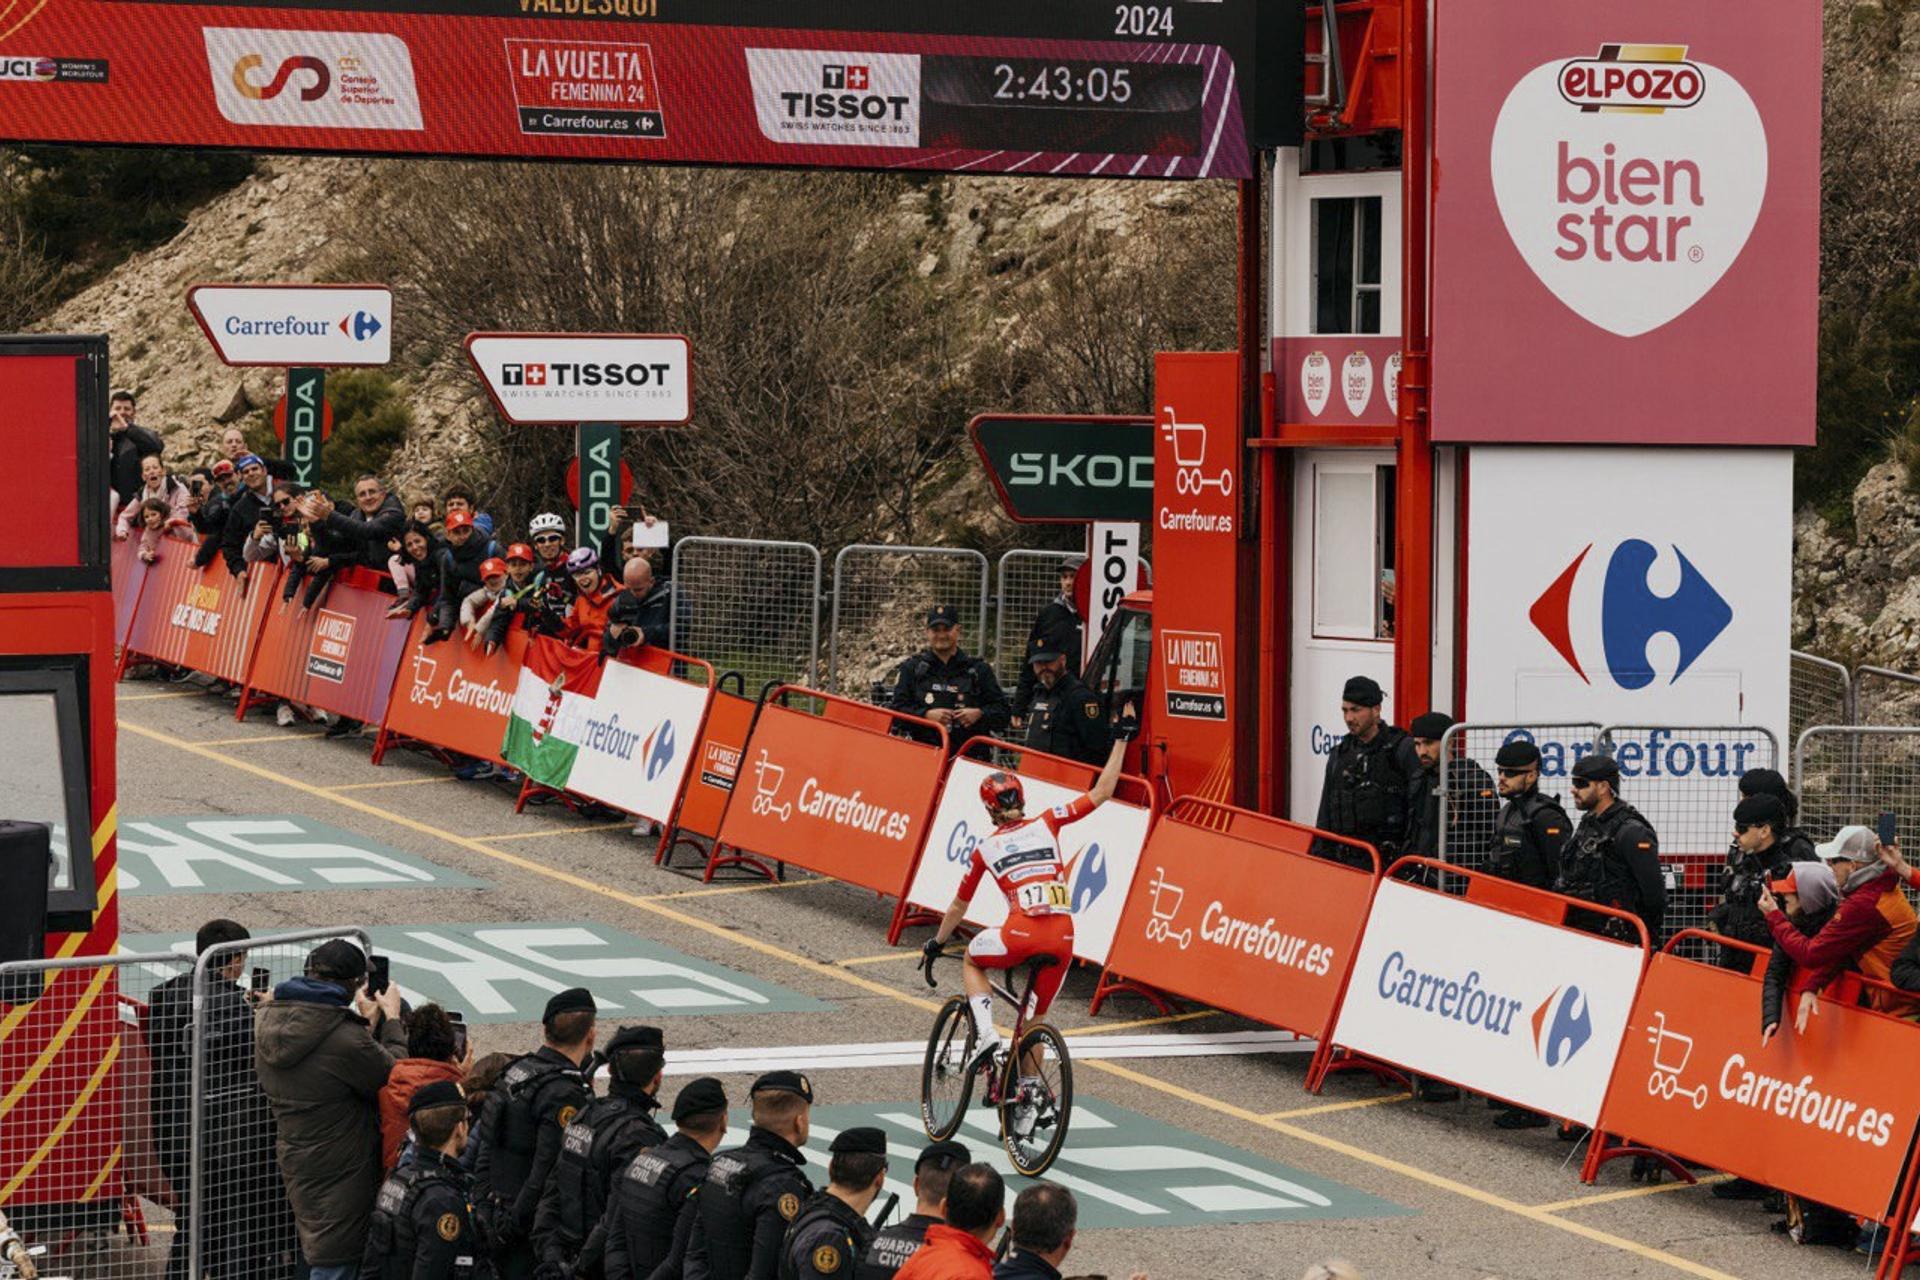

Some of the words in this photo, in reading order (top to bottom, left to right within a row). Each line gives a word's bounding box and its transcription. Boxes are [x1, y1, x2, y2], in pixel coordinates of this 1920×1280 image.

[1115, 5, 1174, 36] 2024
[522, 48, 549, 77] LA
[554, 50, 643, 81] VUELTA
[551, 81, 624, 102] FEMENINA
[627, 84, 646, 103] 24
[993, 64, 1132, 102] 2:43:05
[542, 113, 629, 130] Carrefour.es
[781, 92, 910, 121] TISSOT
[1556, 140, 1705, 206] bien
[1554, 205, 1692, 262] star
[225, 315, 331, 336] Carrefour
[551, 363, 670, 387] TISSOT
[503, 389, 538, 399] SWISS
[545, 389, 599, 399] WATCHES
[606, 389, 640, 399] SINCE
[293, 378, 317, 488] KODA
[1009, 453, 1155, 488] SKOD
[1160, 507, 1232, 533] Carrefour.es
[1168, 639, 1180, 666] LA
[1181, 640, 1218, 668] VUELTA
[798, 777, 911, 841] Carrefour.es
[1025, 885, 1043, 905] 17
[1200, 900, 1334, 977] Carrefour.es
[1378, 950, 1523, 1036] Carrefour
[1718, 1053, 1895, 1147] Carrefour.es
